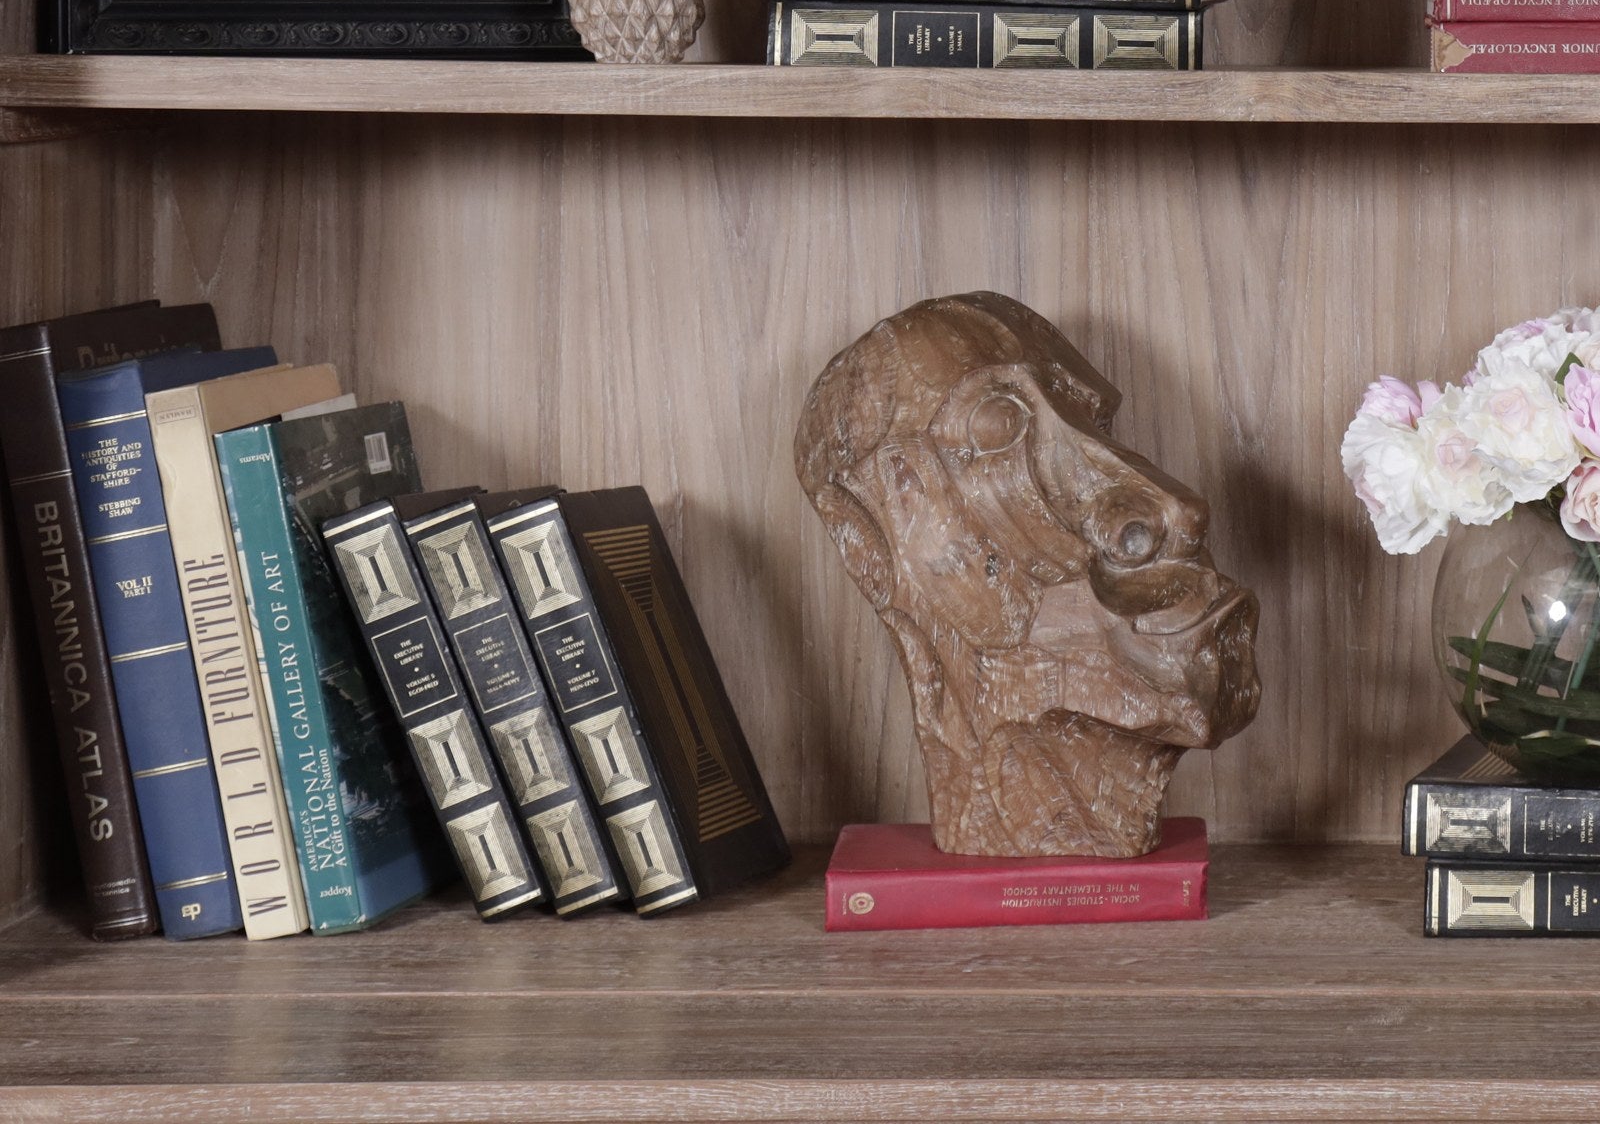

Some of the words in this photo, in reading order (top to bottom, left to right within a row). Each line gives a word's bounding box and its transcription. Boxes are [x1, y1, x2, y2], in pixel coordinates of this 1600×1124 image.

[98, 438, 119, 448] THE
[82, 446, 120, 461] HISTORY
[121, 441, 142, 454] AND
[85, 451, 142, 468] ANTIQUITIES
[239, 452, 274, 464] Abrams
[106, 462, 118, 472] OF
[103, 477, 131, 489] SHIRE
[99, 497, 142, 513] STEBBING
[108, 507, 134, 518] SHAW
[261, 552, 285, 595] ART
[115, 578, 140, 593] VOL
[140, 575, 153, 587] II
[123, 587, 146, 598] PART
[145, 586, 152, 595] I
[271, 599, 292, 633] OF
[182, 553, 255, 726] FURNITURE
[34, 500, 92, 714] BRITANNICA
[73, 726, 114, 843] ATLAS
[279, 642, 310, 740] GALLERY
[318, 748, 334, 791] Nation
[299, 745, 335, 871] NATIONAL
[325, 792, 337, 812] the
[330, 814, 340, 827] to
[220, 745, 289, 918] WORLD
[330, 829, 344, 855] Gift
[335, 856, 348, 867] A
[320, 886, 352, 899] Kopper
[1003, 886, 1038, 897] SCHOOL
[1042, 884, 1101, 895] ELEMENTARY
[1106, 884, 1125, 893] THE
[1129, 883, 1140, 892] IN
[1001, 897, 1062, 908] INSTRUCTION
[1067, 896, 1104, 907] STUDIES
[1110, 894, 1140, 904] SOCIAL
